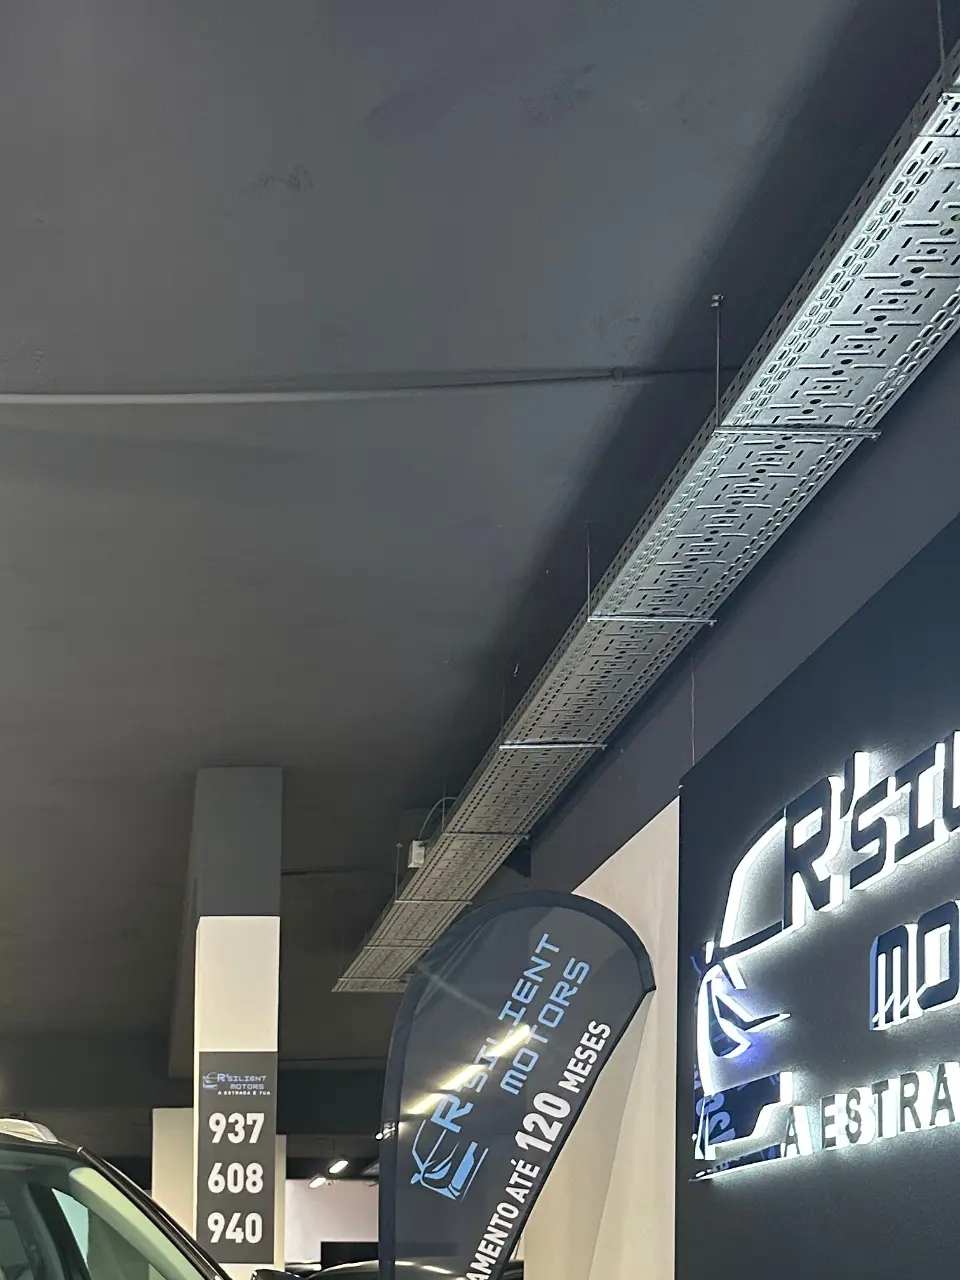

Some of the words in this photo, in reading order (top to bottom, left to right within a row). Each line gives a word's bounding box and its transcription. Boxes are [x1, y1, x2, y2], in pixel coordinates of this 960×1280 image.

[500, 957, 590, 1095] MOTORS
[558, 1020, 611, 1093] MESES
[208, 1112, 265, 1144] 937
[515, 1092, 570, 1152] 120
[821, 1063, 960, 1150] ESTRA
[207, 1162, 264, 1194] 608
[505, 1159, 540, 1204] ATÉ
[207, 1211, 263, 1244] 940
